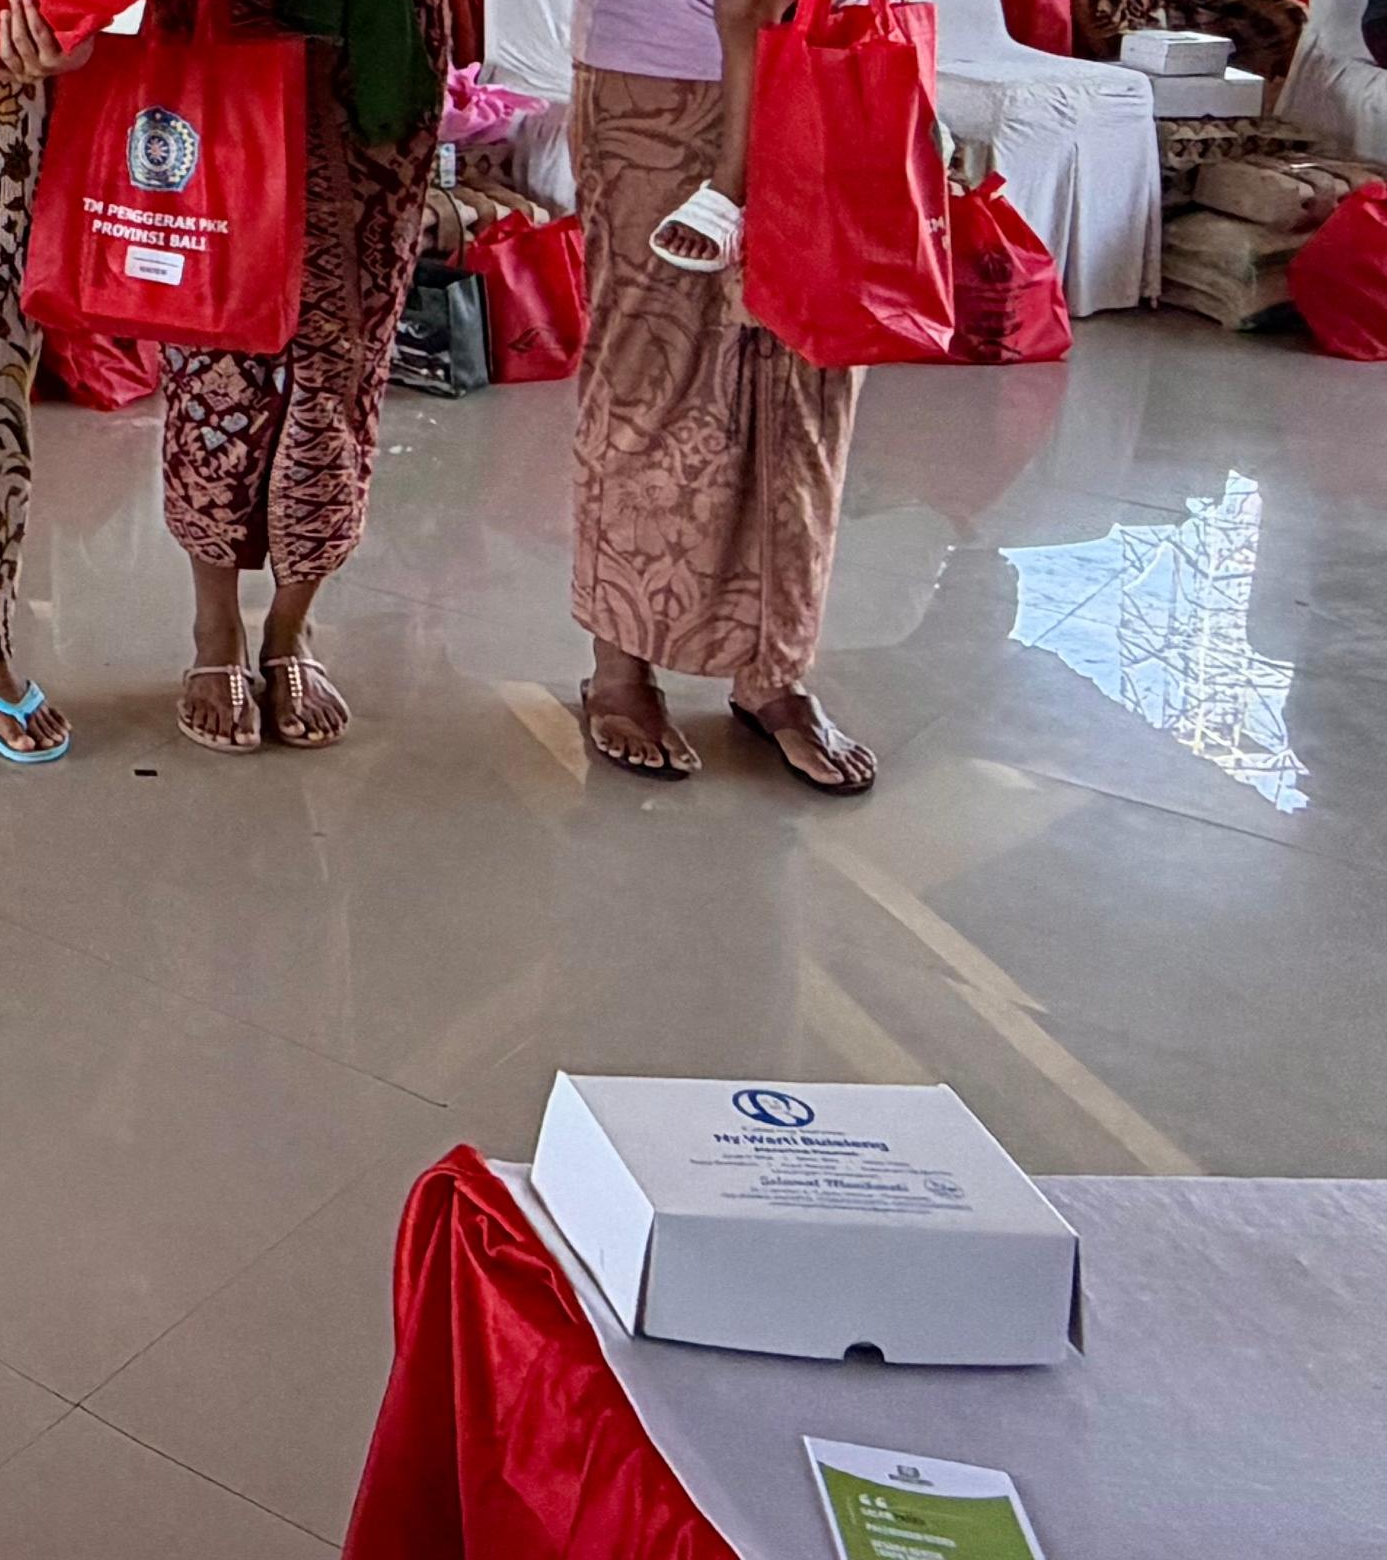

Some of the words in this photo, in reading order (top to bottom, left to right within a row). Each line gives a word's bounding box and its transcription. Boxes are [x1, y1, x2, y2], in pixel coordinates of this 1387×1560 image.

[107, 203, 196, 231] PENGGERAK
[199, 217, 229, 233] PKK
[92, 219, 165, 246] PROVINSI
[170, 234, 207, 251] BALI
[743, 1134, 797, 1146] Warti
[803, 1136, 890, 1152] Buleleng
